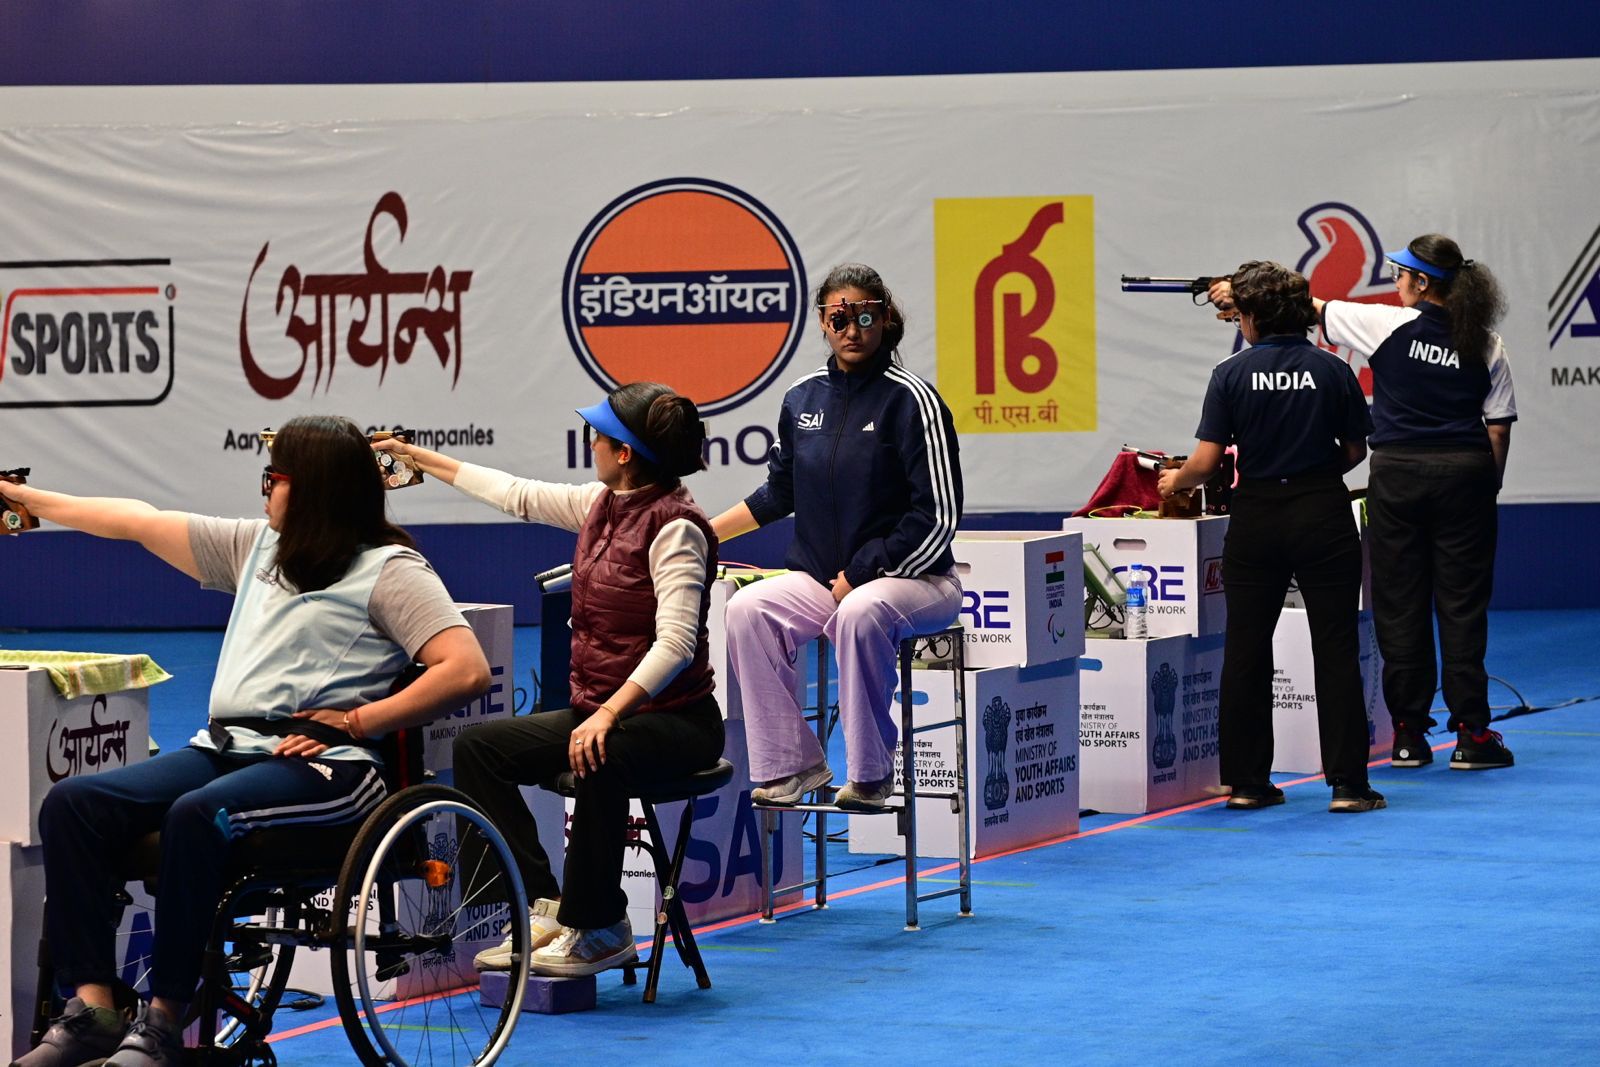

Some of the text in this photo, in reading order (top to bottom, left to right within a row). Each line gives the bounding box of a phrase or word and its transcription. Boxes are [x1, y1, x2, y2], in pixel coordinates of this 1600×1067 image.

[580, 274, 790, 325] इंडियनऑयल
[11, 310, 160, 376] SPORTS
[1407, 339, 1460, 369] INDIA
[1251, 370, 1317, 391] INDIA
[1551, 365, 1600, 387] MAK
[797, 412, 825, 428] SAI
[973, 400, 1059, 427] पी.एस.बी
[223, 429, 261, 455] Aary
[393, 424, 495, 451] mpanies
[961, 591, 1011, 628] RE
[1049, 598, 1062, 609] INDIA
[1156, 605, 1186, 614] WORK
[980, 634, 1012, 643] WORK
[1281, 693, 1316, 702] AFFAIRS
[1213, 705, 1219, 720] O
[430, 727, 456, 740] MAKING
[1079, 730, 1140, 739] OUTH AFFAIRS
[1108, 722, 1118, 730] OF
[1182, 726, 1208, 744] YOUTH
[1015, 740, 1058, 763] MINISTRY OF
[1079, 739, 1127, 748] ND SPORTS
[1182, 745, 1200, 763] AND
[934, 760, 945, 768] OF
[1015, 755, 1076, 783] YOUTH AFFAIRS
[930, 769, 957, 778] AFFAI
[919, 779, 955, 788] SPORTS
[1015, 777, 1065, 803] AND SPORTS
[465, 922, 490, 942] AND
